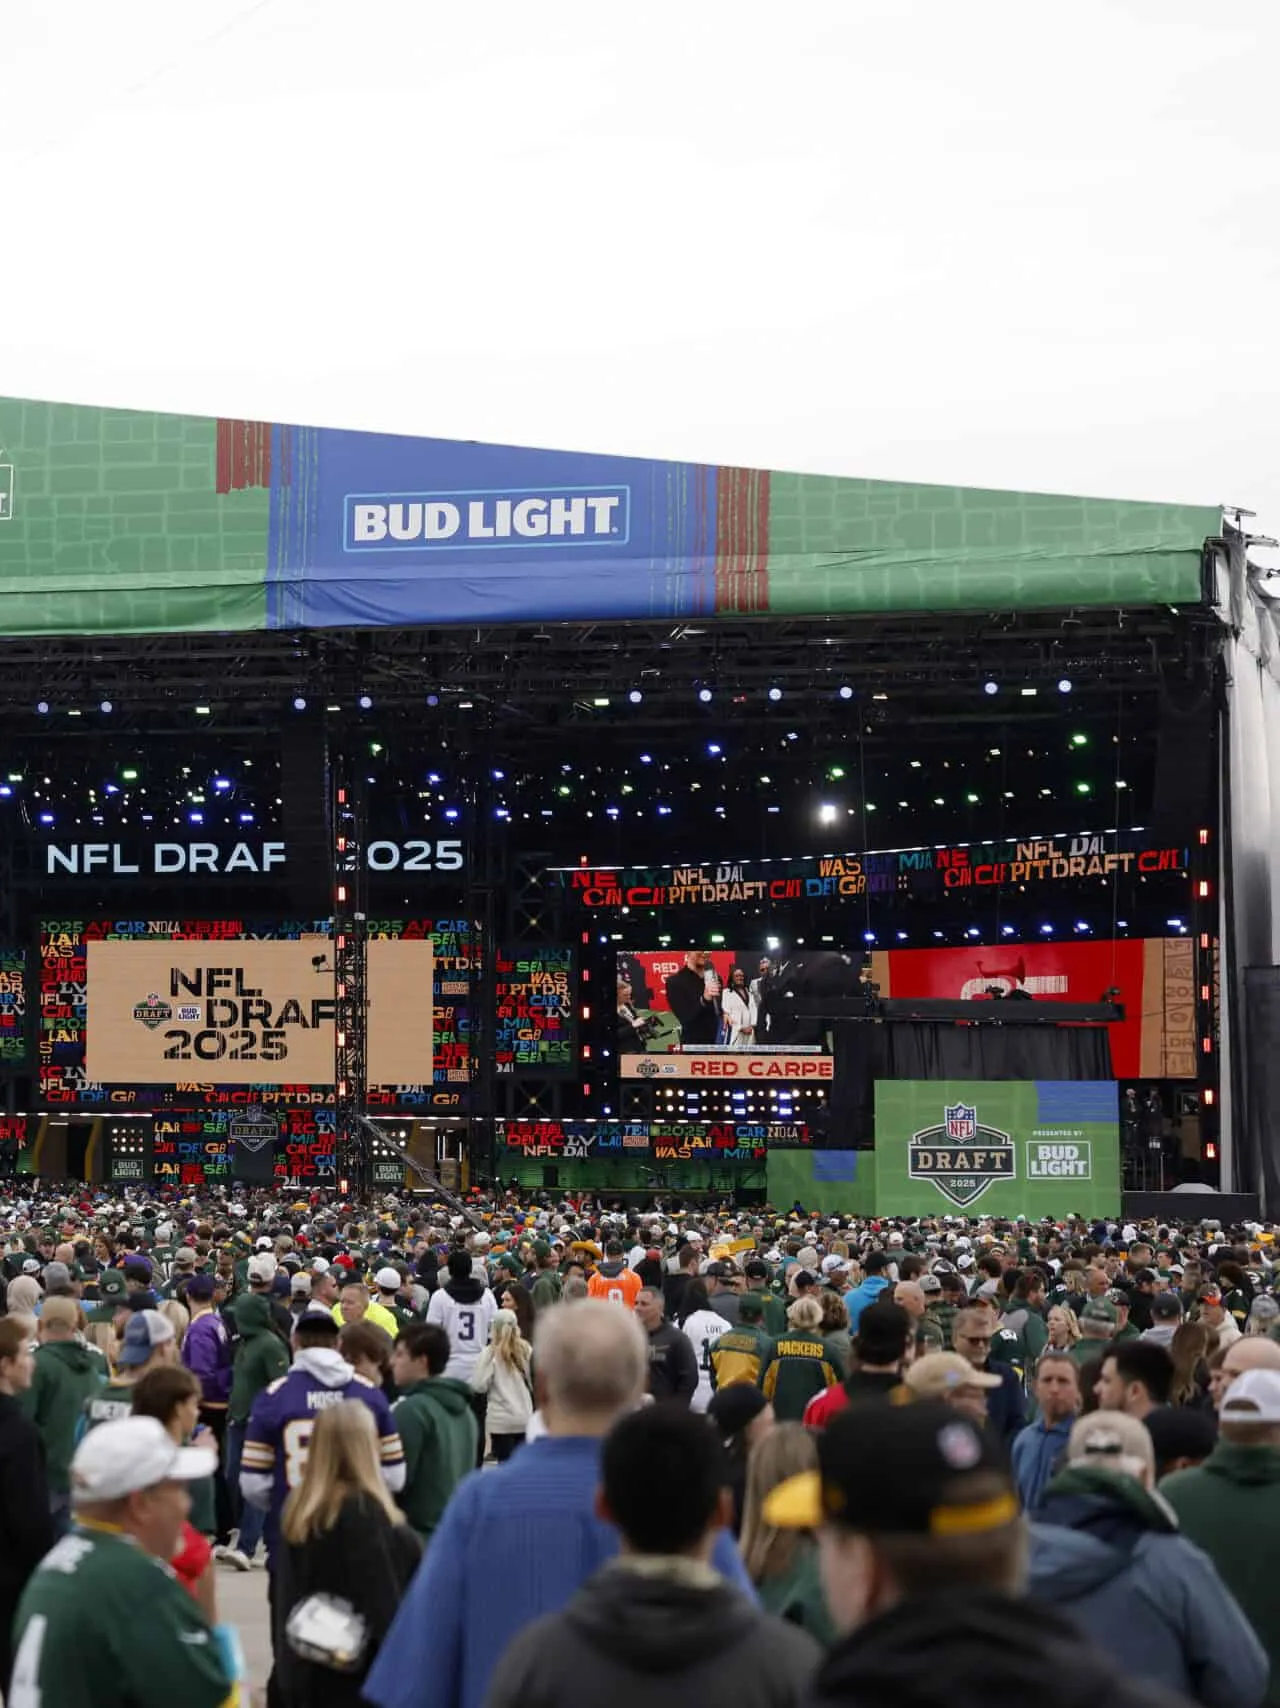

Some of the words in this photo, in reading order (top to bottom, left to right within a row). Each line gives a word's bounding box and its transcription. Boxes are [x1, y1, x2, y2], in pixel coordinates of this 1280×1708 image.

[354, 503, 460, 541] BUD
[468, 497, 619, 537] LIGHT
[47, 843, 139, 873] NFL
[154, 842, 287, 872] DRAF
[344, 840, 463, 871] 025
[1016, 840, 1062, 862] NFL
[673, 868, 710, 886] NFL
[819, 857, 861, 877] WAS
[366, 920, 403, 933] 025
[652, 962, 679, 974] RED
[170, 967, 264, 998] NFL
[135, 1009, 170, 1019] DRAFT
[207, 999, 338, 1029] DRAF
[163, 1030, 288, 1061] 2025
[690, 1061, 738, 1076] RED
[748, 1061, 833, 1077] CARPE
[950, 1120, 974, 1137] NFL
[524, 1145, 558, 1157] NFL
[1038, 1145, 1080, 1160] BUD
[917, 1151, 1007, 1169] DRAFT
[1030, 1160, 1087, 1176] LIGHT
[950, 1179, 976, 1188] 2025
[458, 1311, 475, 1341] 3
[777, 1341, 824, 1358] PACKERS
